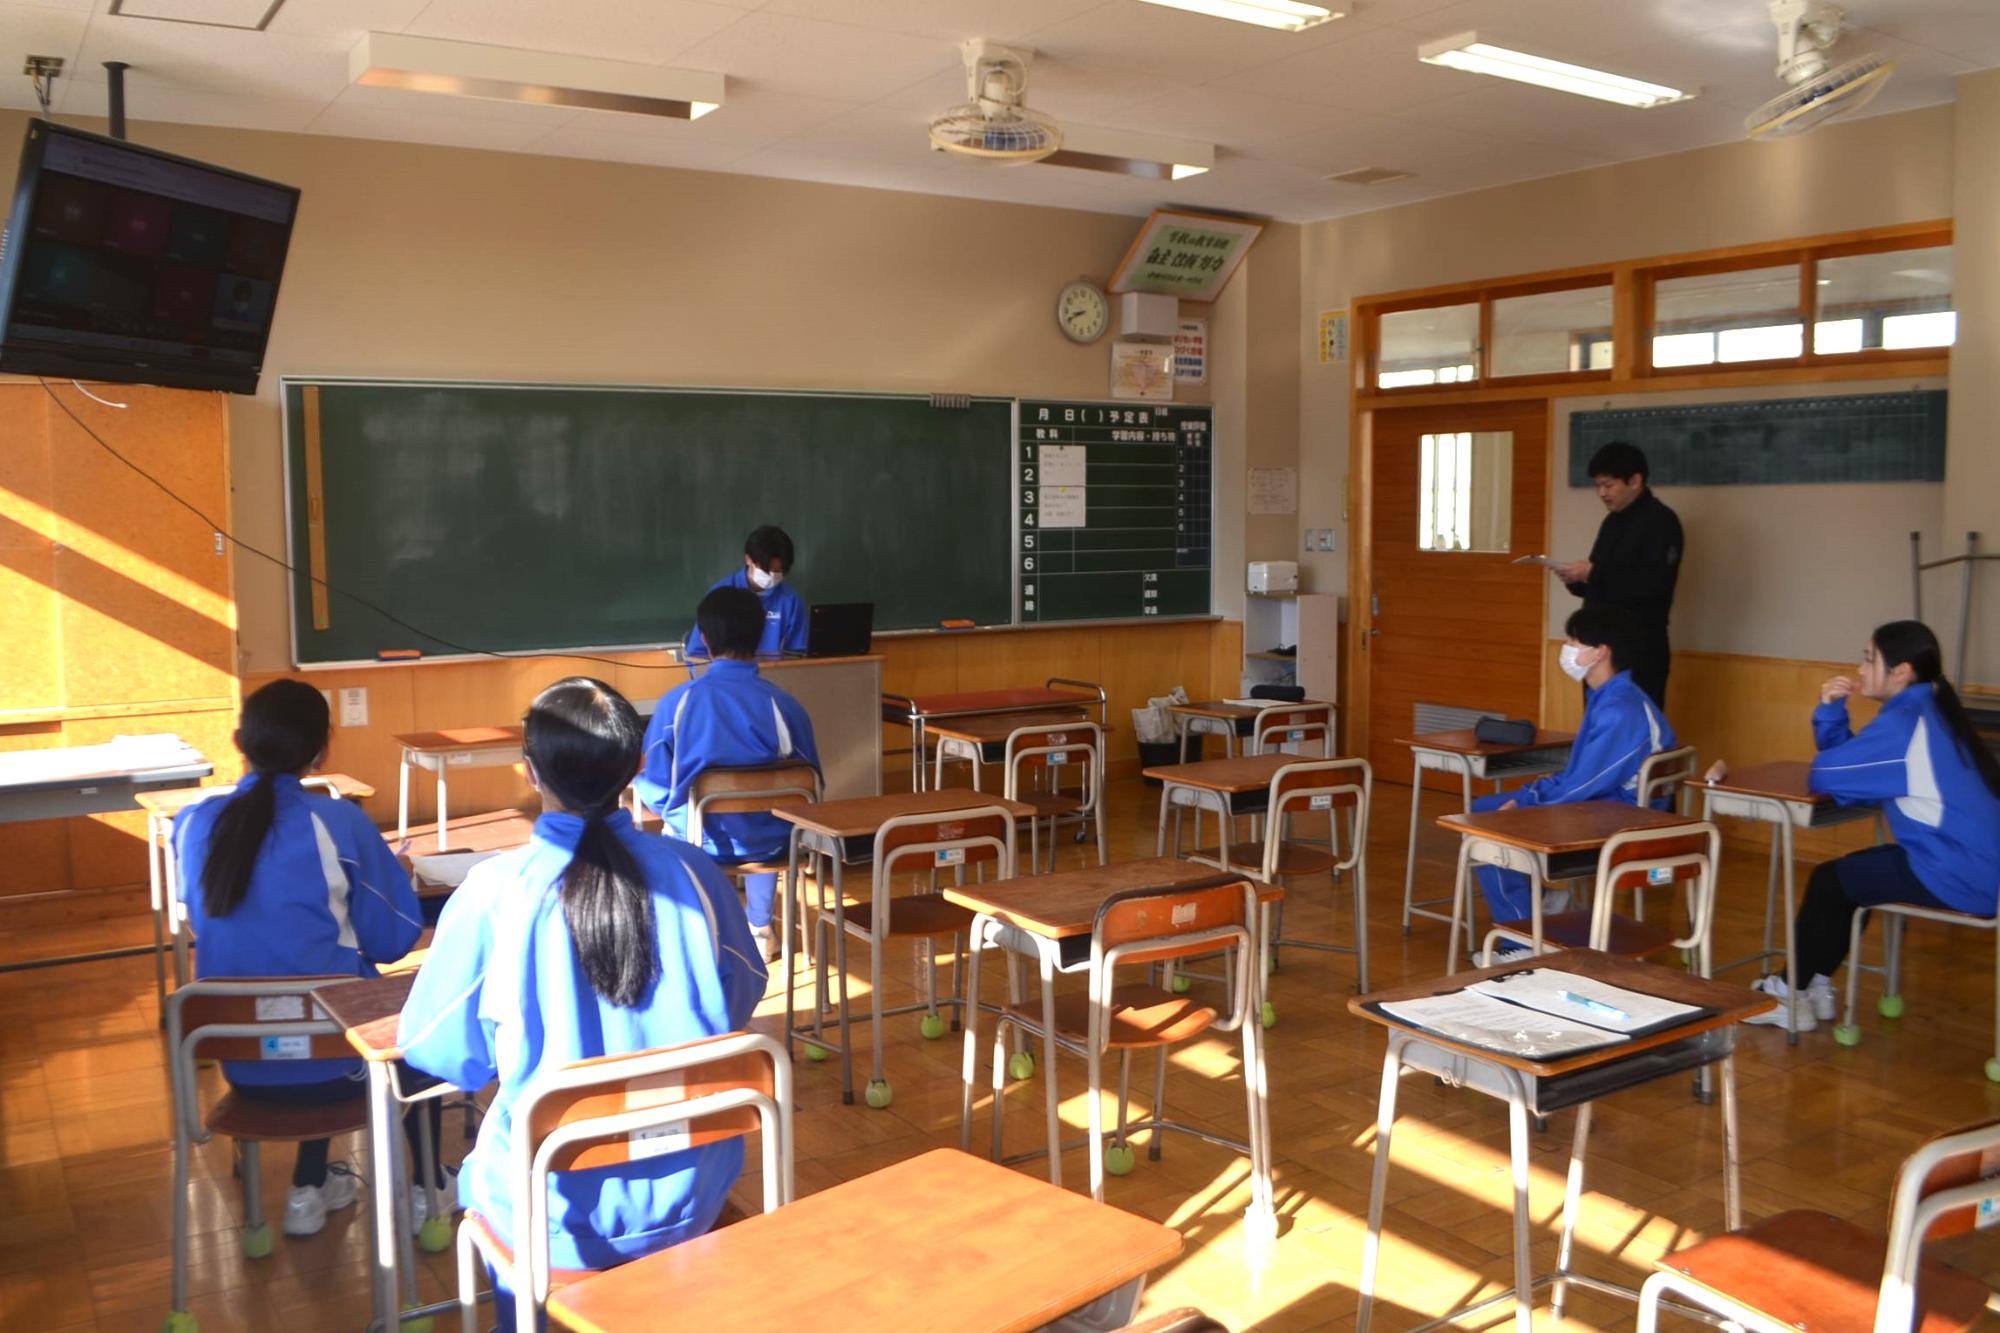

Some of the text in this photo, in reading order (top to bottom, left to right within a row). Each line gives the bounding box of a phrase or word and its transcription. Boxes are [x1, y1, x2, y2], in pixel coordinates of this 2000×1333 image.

[1038, 408, 1049, 421] 月
[1064, 409, 1075, 421] 日
[1025, 446, 1032, 459] 1
[1024, 468, 1034, 481] 2
[1024, 491, 1034, 504] 3
[1024, 513, 1034, 526] 4
[1024, 535, 1034, 548] 5
[1024, 557, 1034, 570] 6
